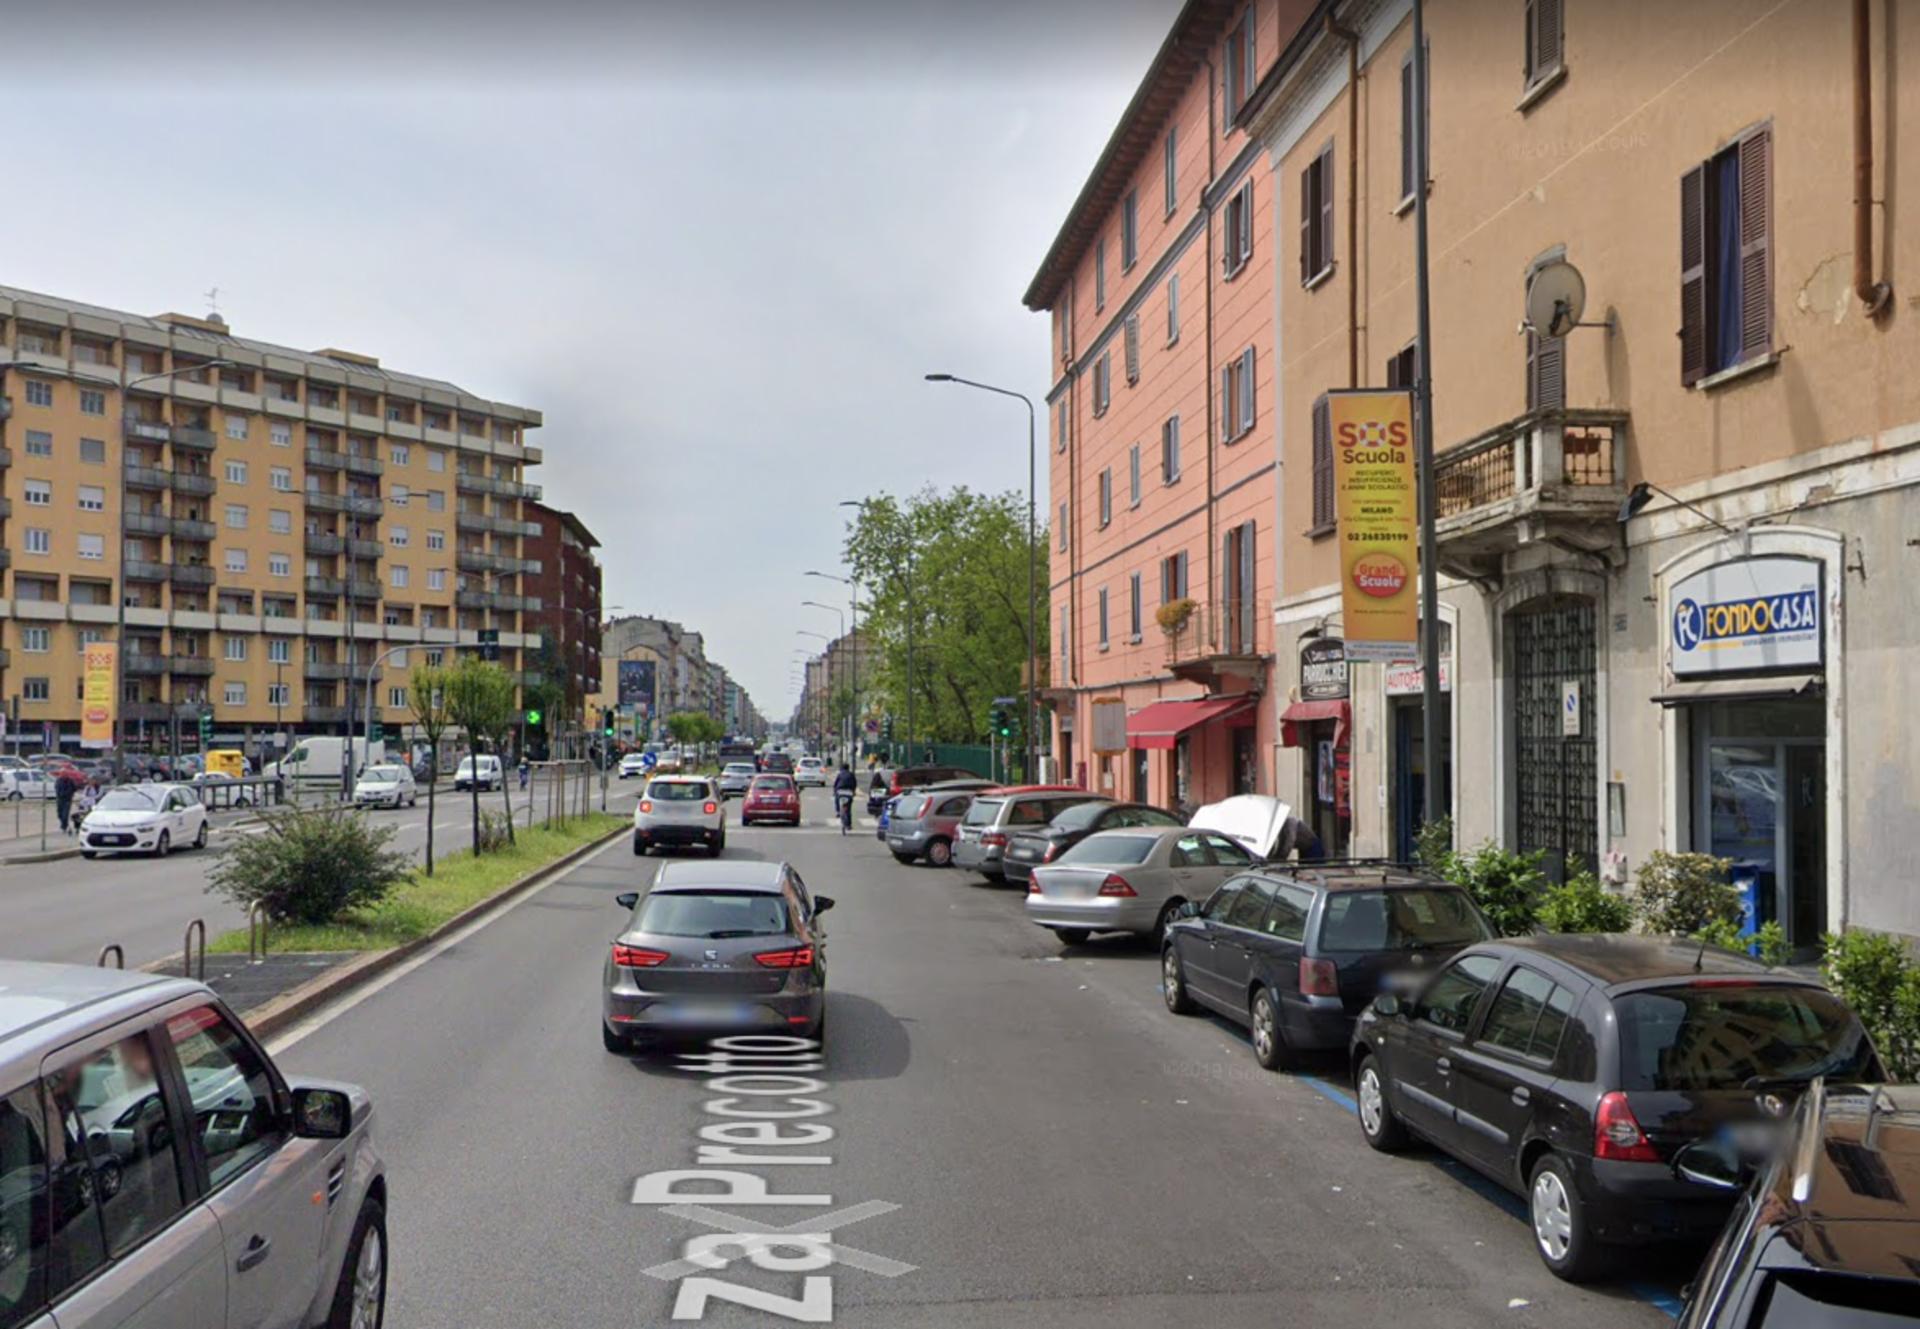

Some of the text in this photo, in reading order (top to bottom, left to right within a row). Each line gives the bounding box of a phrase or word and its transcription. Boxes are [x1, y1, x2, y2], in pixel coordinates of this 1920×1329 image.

[1338, 421, 1408, 448] SOS
[1343, 448, 1406, 464] Scuola
[1360, 564, 1400, 576] Grandi
[1706, 595, 1815, 637] FONDOCASA
